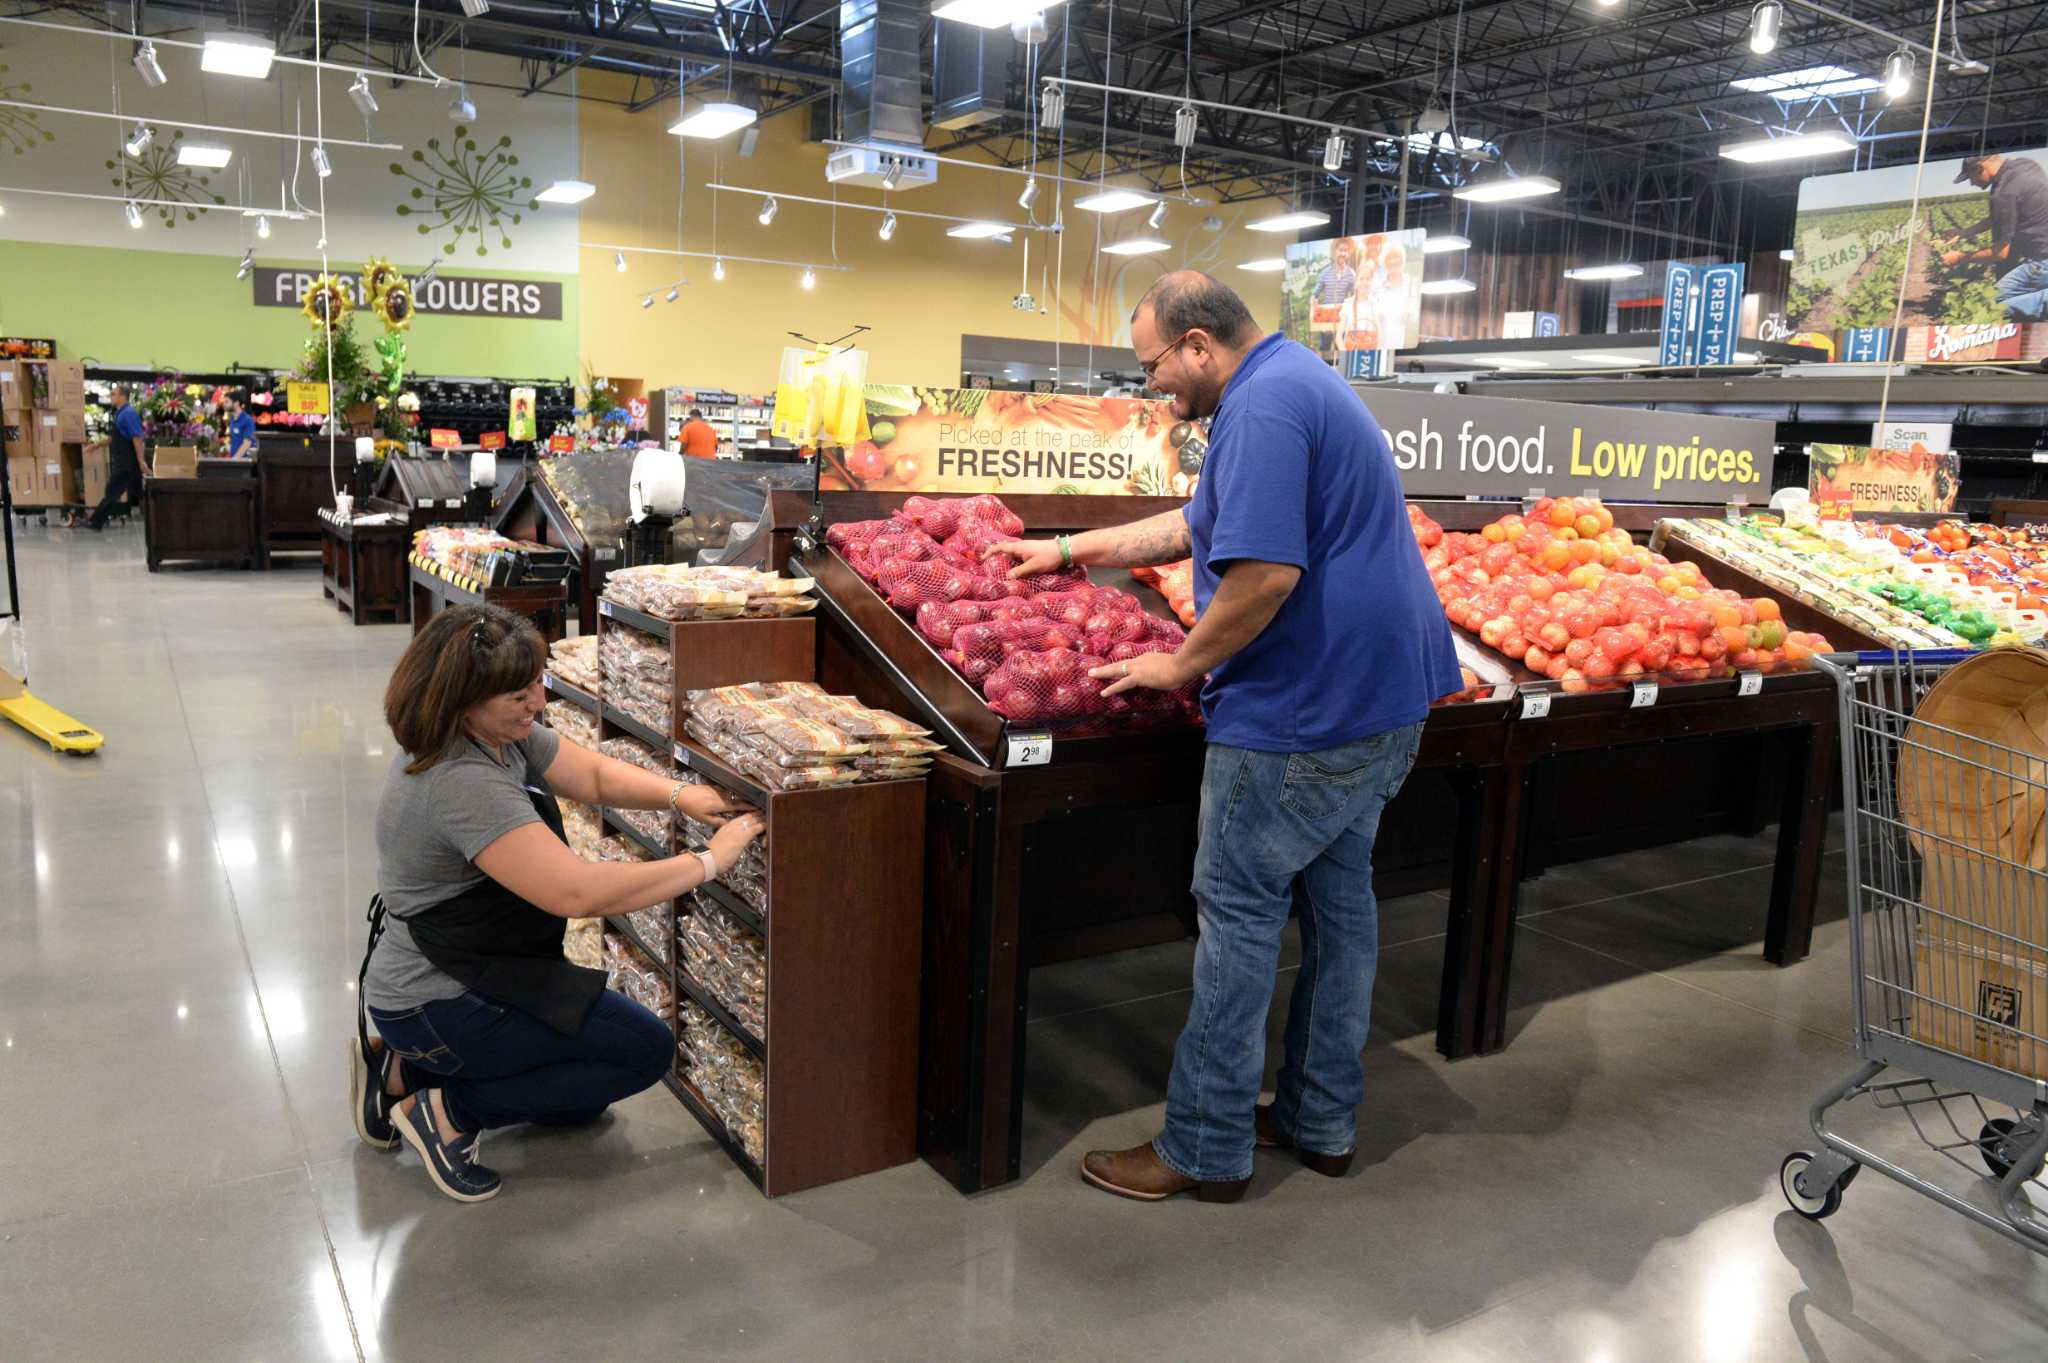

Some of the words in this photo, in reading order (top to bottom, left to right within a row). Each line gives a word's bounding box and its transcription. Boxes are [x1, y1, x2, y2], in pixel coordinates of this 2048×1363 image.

[938, 423, 1004, 446] Picked
[1010, 426, 1028, 447] at
[1035, 428, 1063, 447] the
[1069, 430, 1113, 450] peak
[1118, 431, 1137, 450] of
[937, 448, 1133, 480] FRESHNESS!
[1457, 419, 1554, 475] food.
[1570, 427, 1647, 477] Low
[1653, 435, 1761, 490] prices.
[1849, 482, 1921, 503] FRESHNESS!
